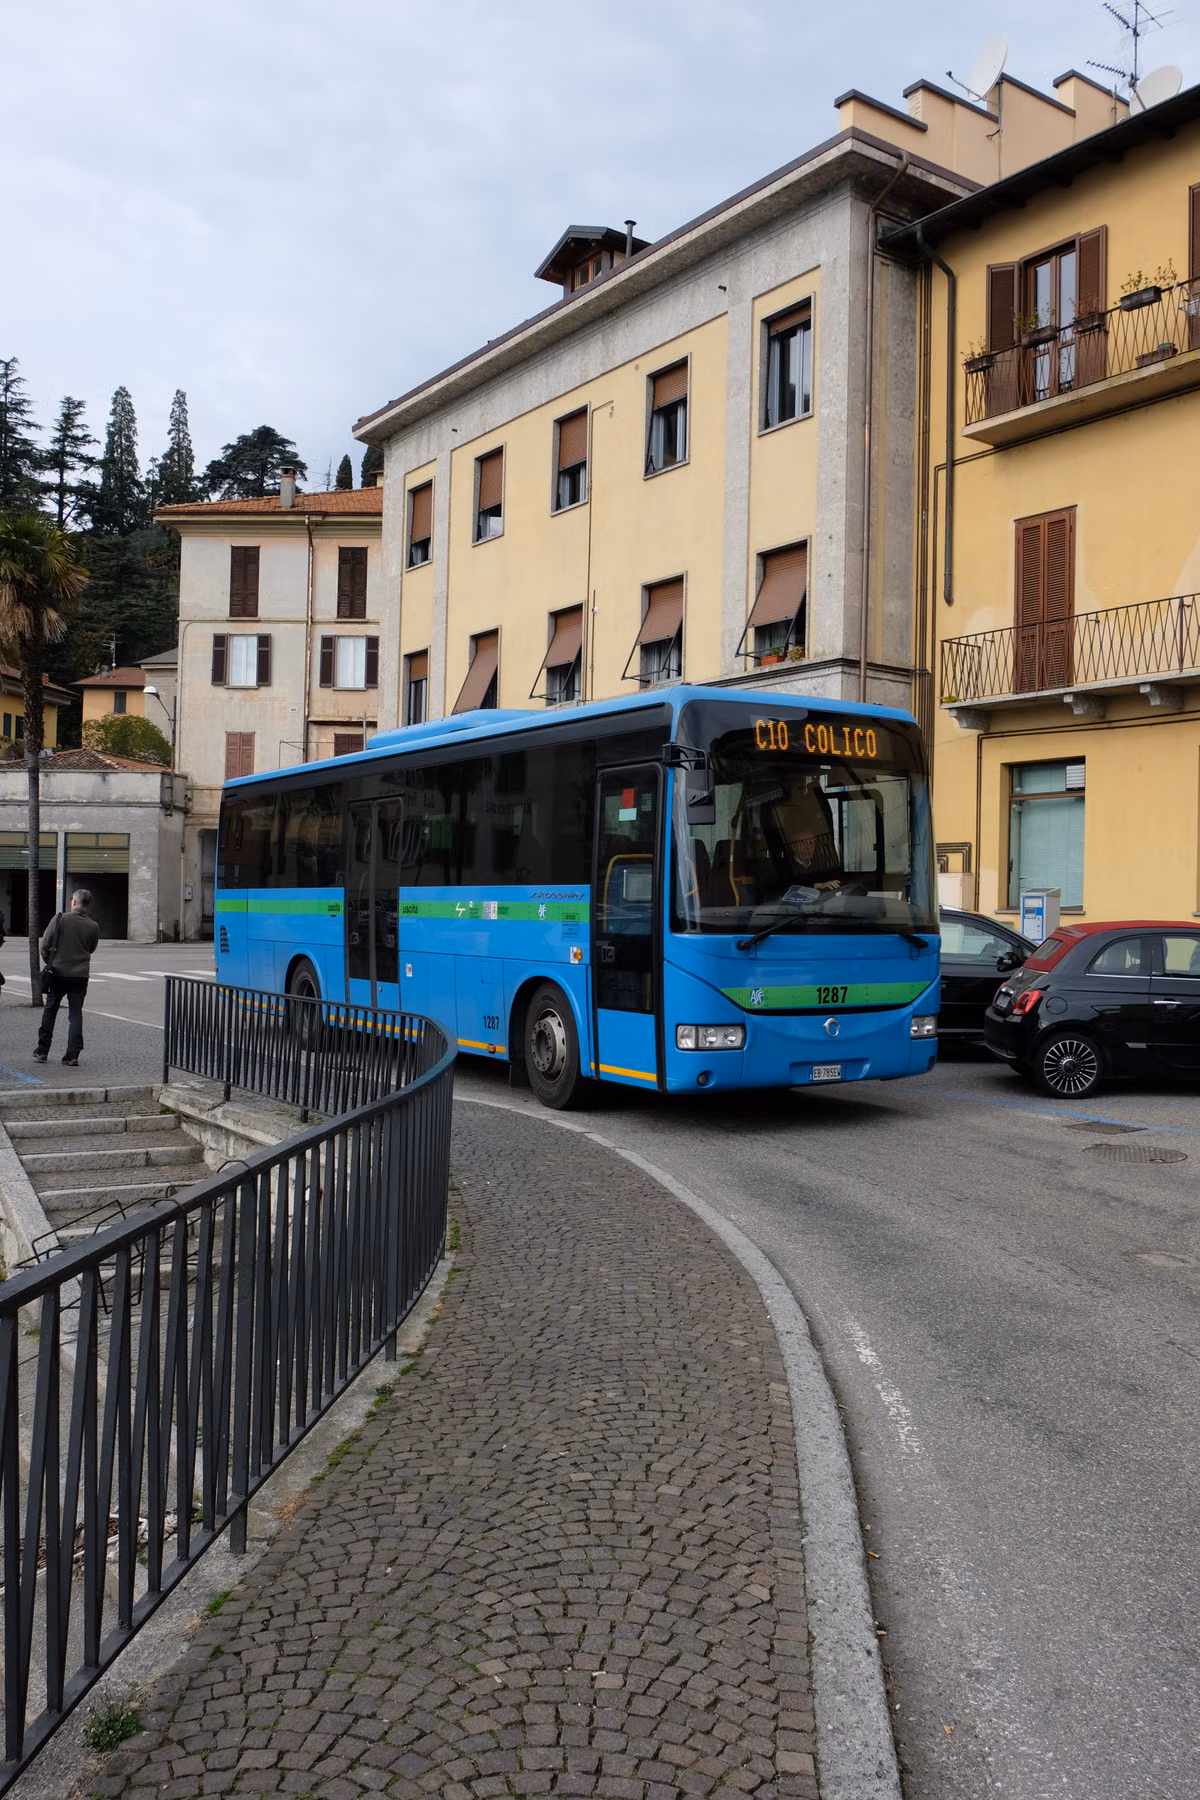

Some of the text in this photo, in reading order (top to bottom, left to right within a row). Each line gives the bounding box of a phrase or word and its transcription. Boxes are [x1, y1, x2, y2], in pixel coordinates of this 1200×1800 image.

[755, 719, 877, 757] C10 COLICO
[402, 904, 419, 914] uscita
[817, 986, 848, 1004] 1287
[483, 1015, 500, 1031] 1287
